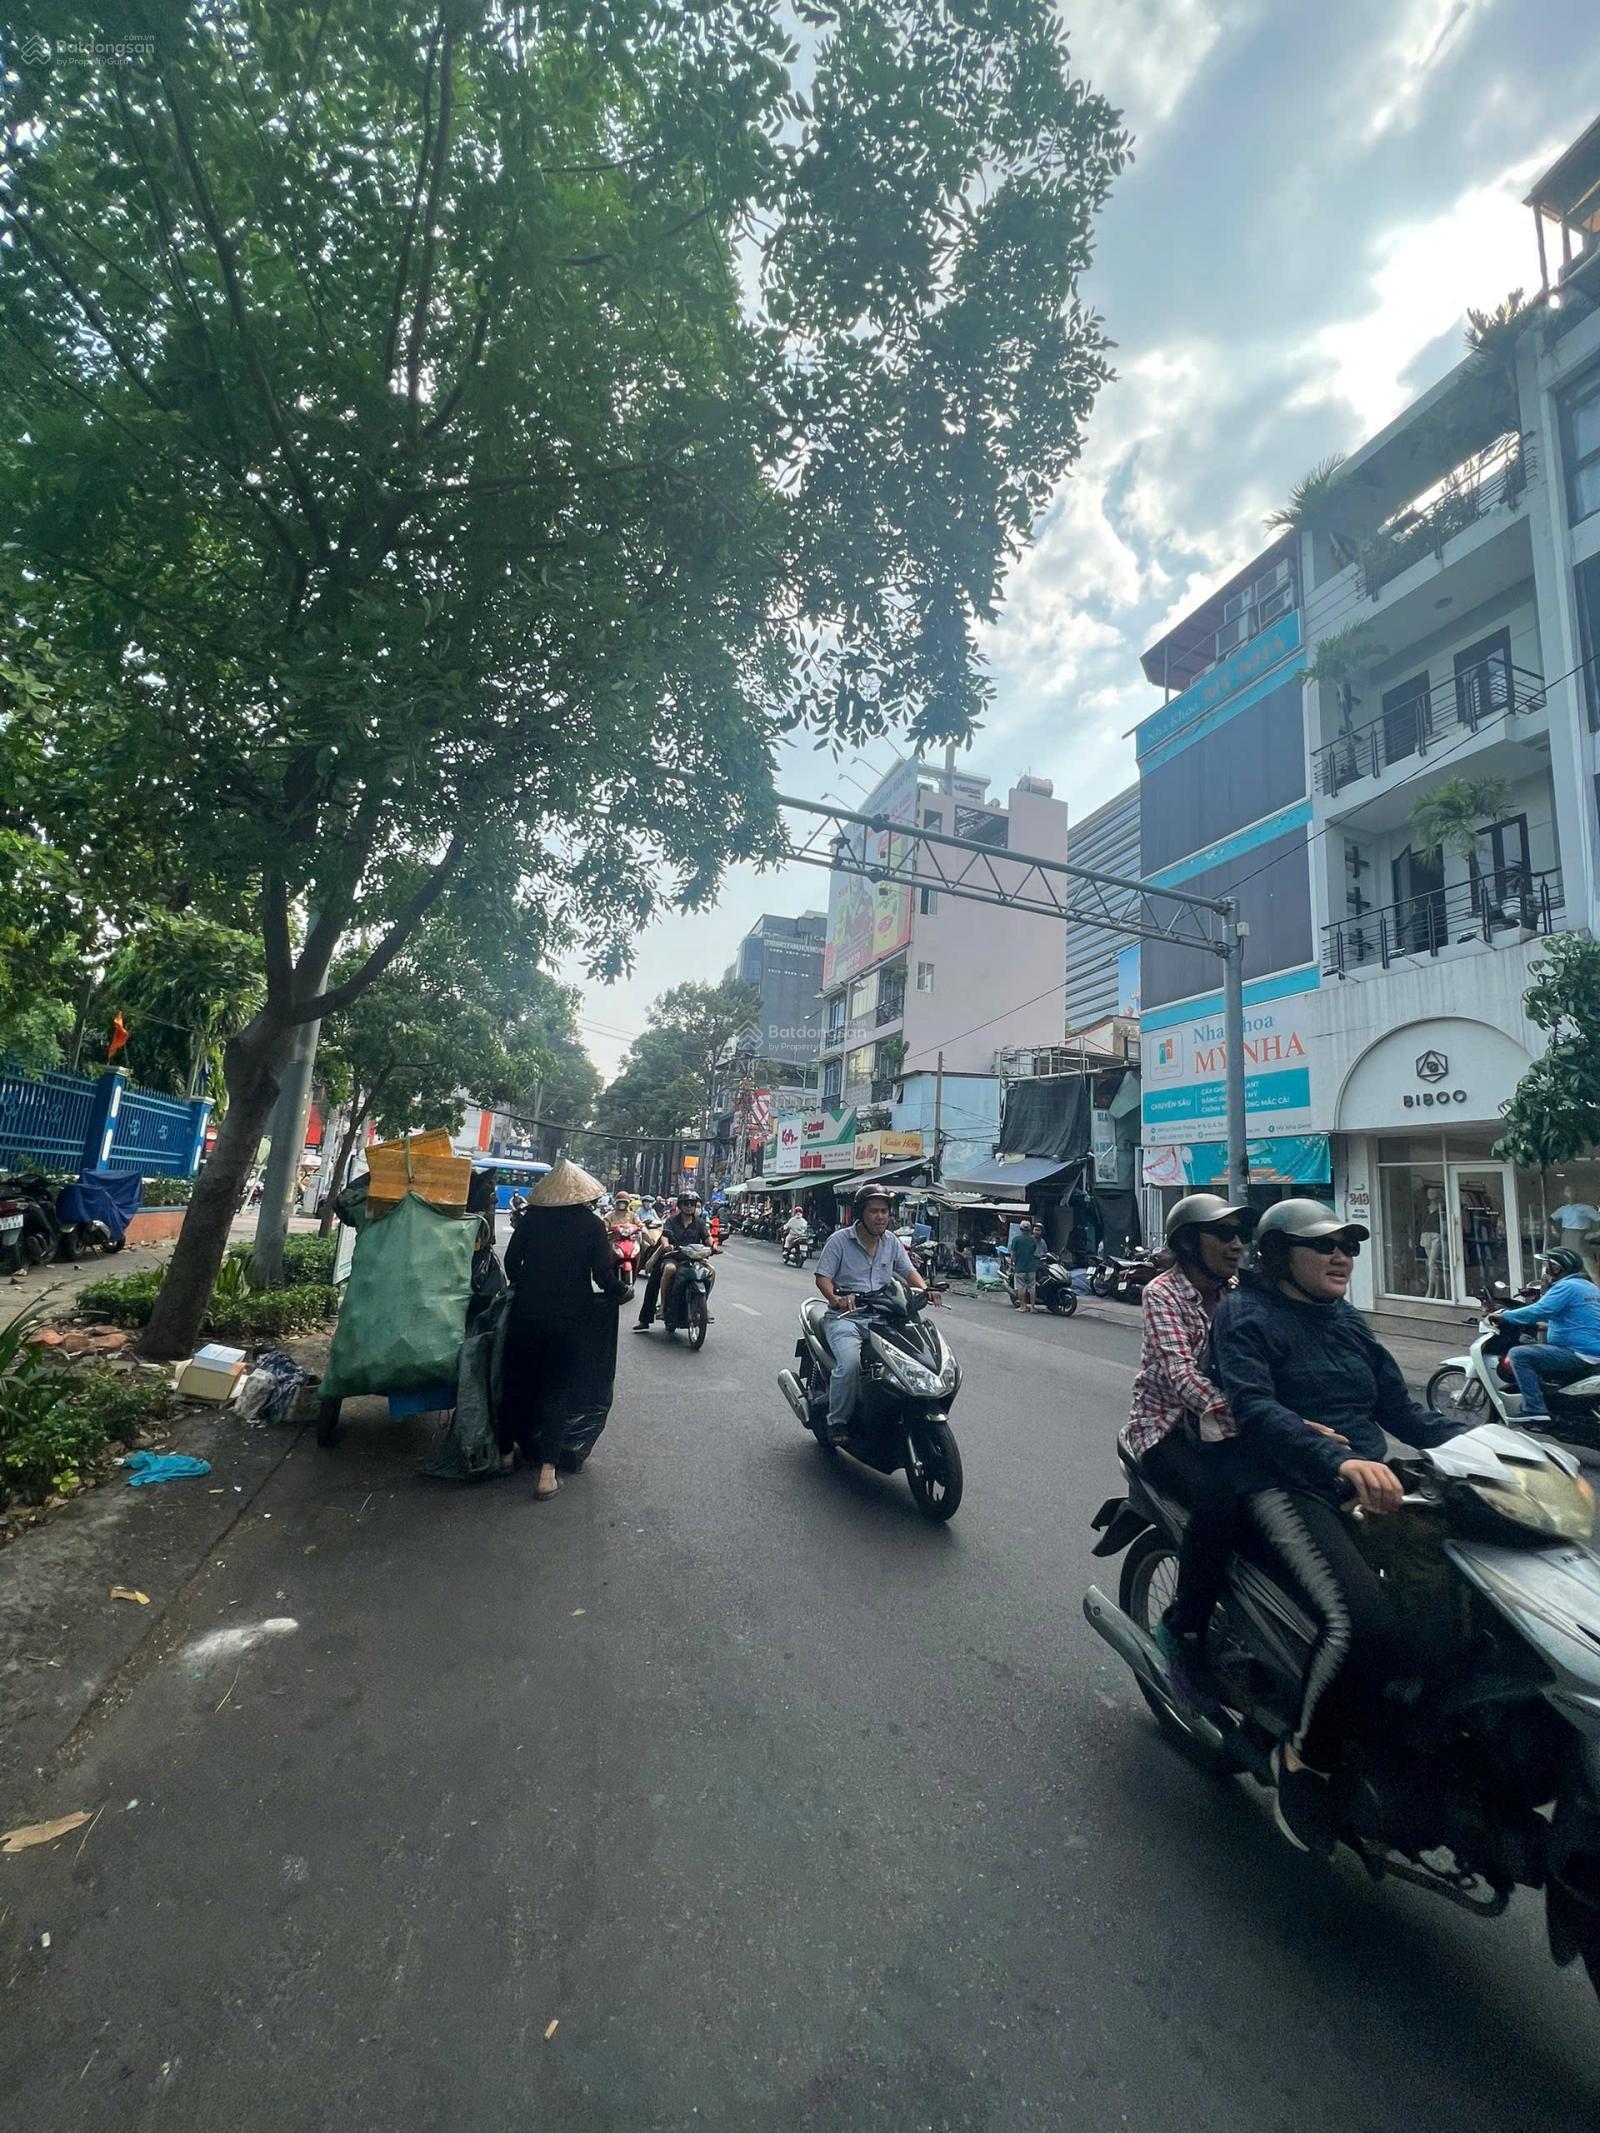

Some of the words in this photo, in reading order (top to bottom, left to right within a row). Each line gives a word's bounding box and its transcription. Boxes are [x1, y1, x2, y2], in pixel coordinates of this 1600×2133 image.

[1193, 1024, 1225, 1044] Nha
[1243, 1015, 1274, 1034] hoa
[1243, 1031, 1306, 1066] NHA
[1403, 1089, 1468, 1109] BIBOO
[1349, 1192, 1370, 1206] 243
